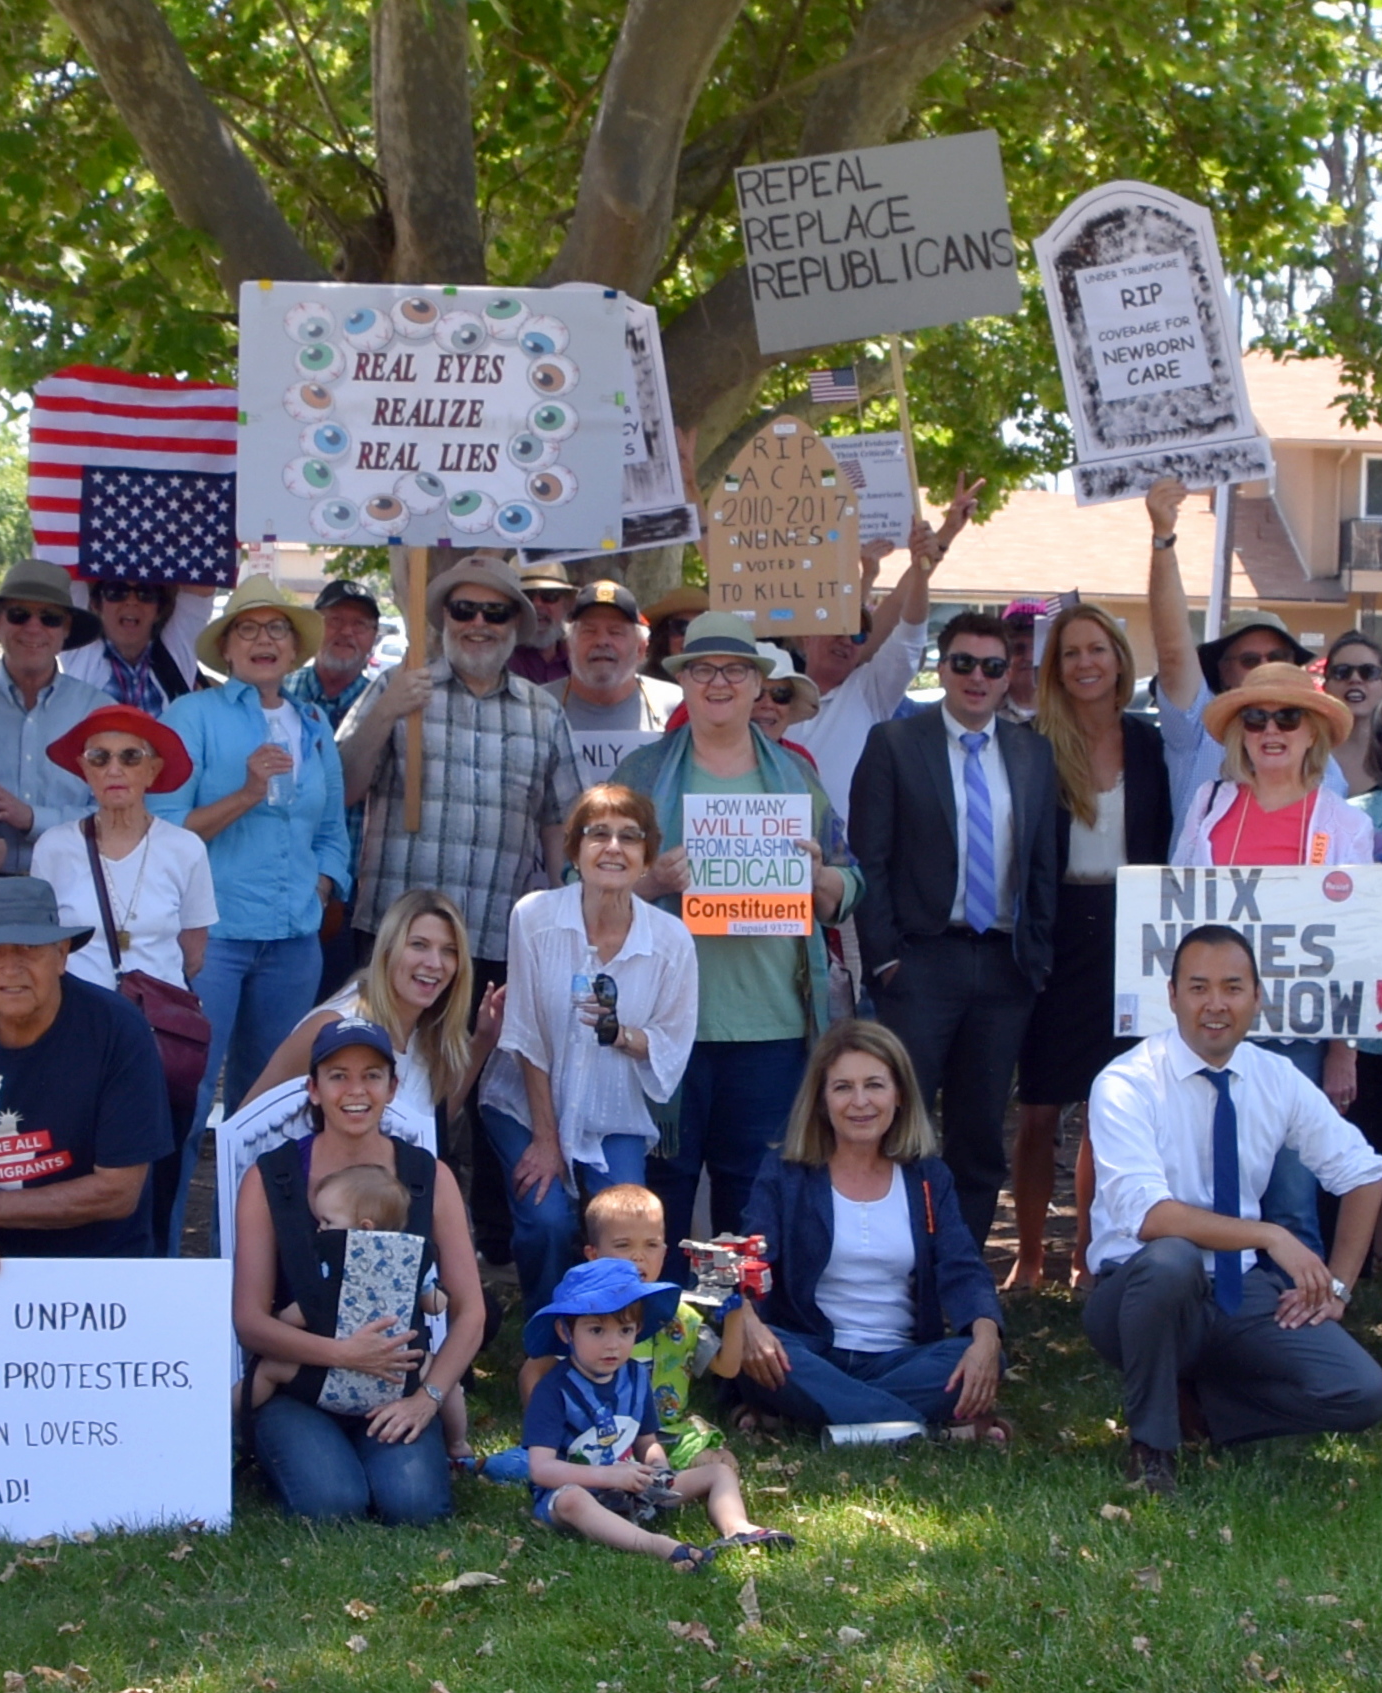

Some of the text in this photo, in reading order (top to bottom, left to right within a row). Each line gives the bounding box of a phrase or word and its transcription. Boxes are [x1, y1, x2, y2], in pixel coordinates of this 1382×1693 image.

[737, 155, 882, 208] REPEAL
[744, 195, 915, 255] REPLACE
[751, 228, 1014, 301] REPUBLICANS
[1084, 258, 1179, 284] UNDER TRUMPCARE
[1120, 282, 1163, 310] RIP
[1098, 316, 1191, 342] COVERAGE FOR
[1102, 335, 1196, 366] NEWBORN
[352, 352, 505, 384] REAL EYES
[1127, 359, 1181, 386] CARE
[372, 397, 485, 428] REALIZE
[355, 441, 500, 473] REAL LIES
[753, 436, 816, 460] RIP
[739, 464, 816, 491] ACA
[722, 495, 848, 527] 2010-2017
[737, 526, 823, 550] NUNES
[746, 558, 796, 573] VOTED
[719, 581, 839, 603] TO KILL IT
[582, 743, 623, 767] NLY
[706, 799, 787, 816] HOW MANY
[692, 818, 802, 836] WILL DIE
[686, 838, 730, 857] FROM
[688, 858, 804, 887] MEDICAID
[686, 897, 807, 919] Constituent
[733, 923, 800, 935] Unpaid 93727
[16, 1137, 42, 1150] ALL
[14, 1301, 127, 1332] UNPAID
